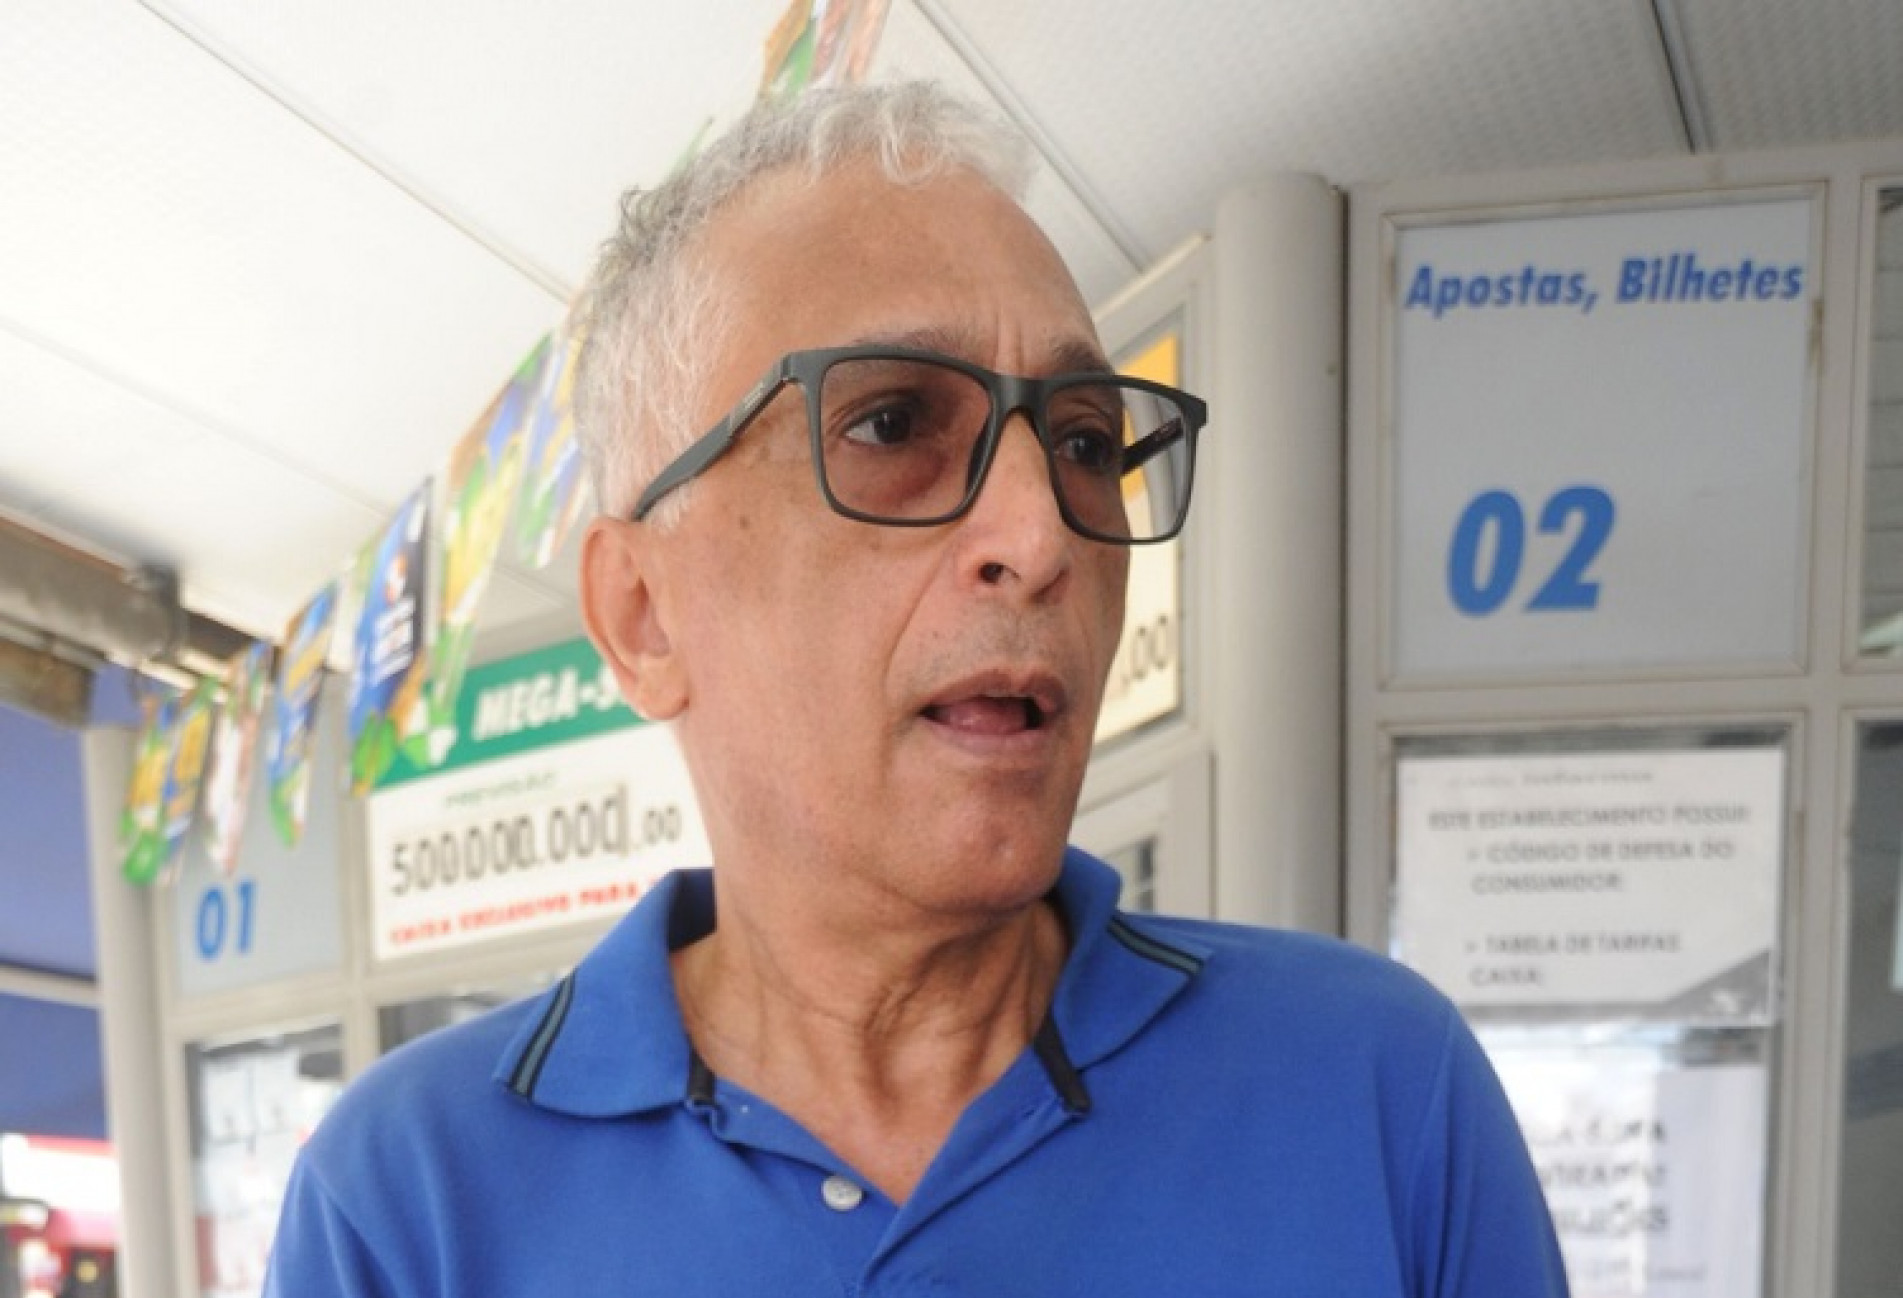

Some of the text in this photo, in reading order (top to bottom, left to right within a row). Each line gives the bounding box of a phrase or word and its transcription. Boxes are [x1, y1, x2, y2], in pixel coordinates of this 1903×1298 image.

[1404, 251, 1804, 319] Apostas, Bilhetes
[1446, 484, 1617, 617] 02
[1587, 841, 1613, 861] DE
[194, 880, 257, 961] 01
